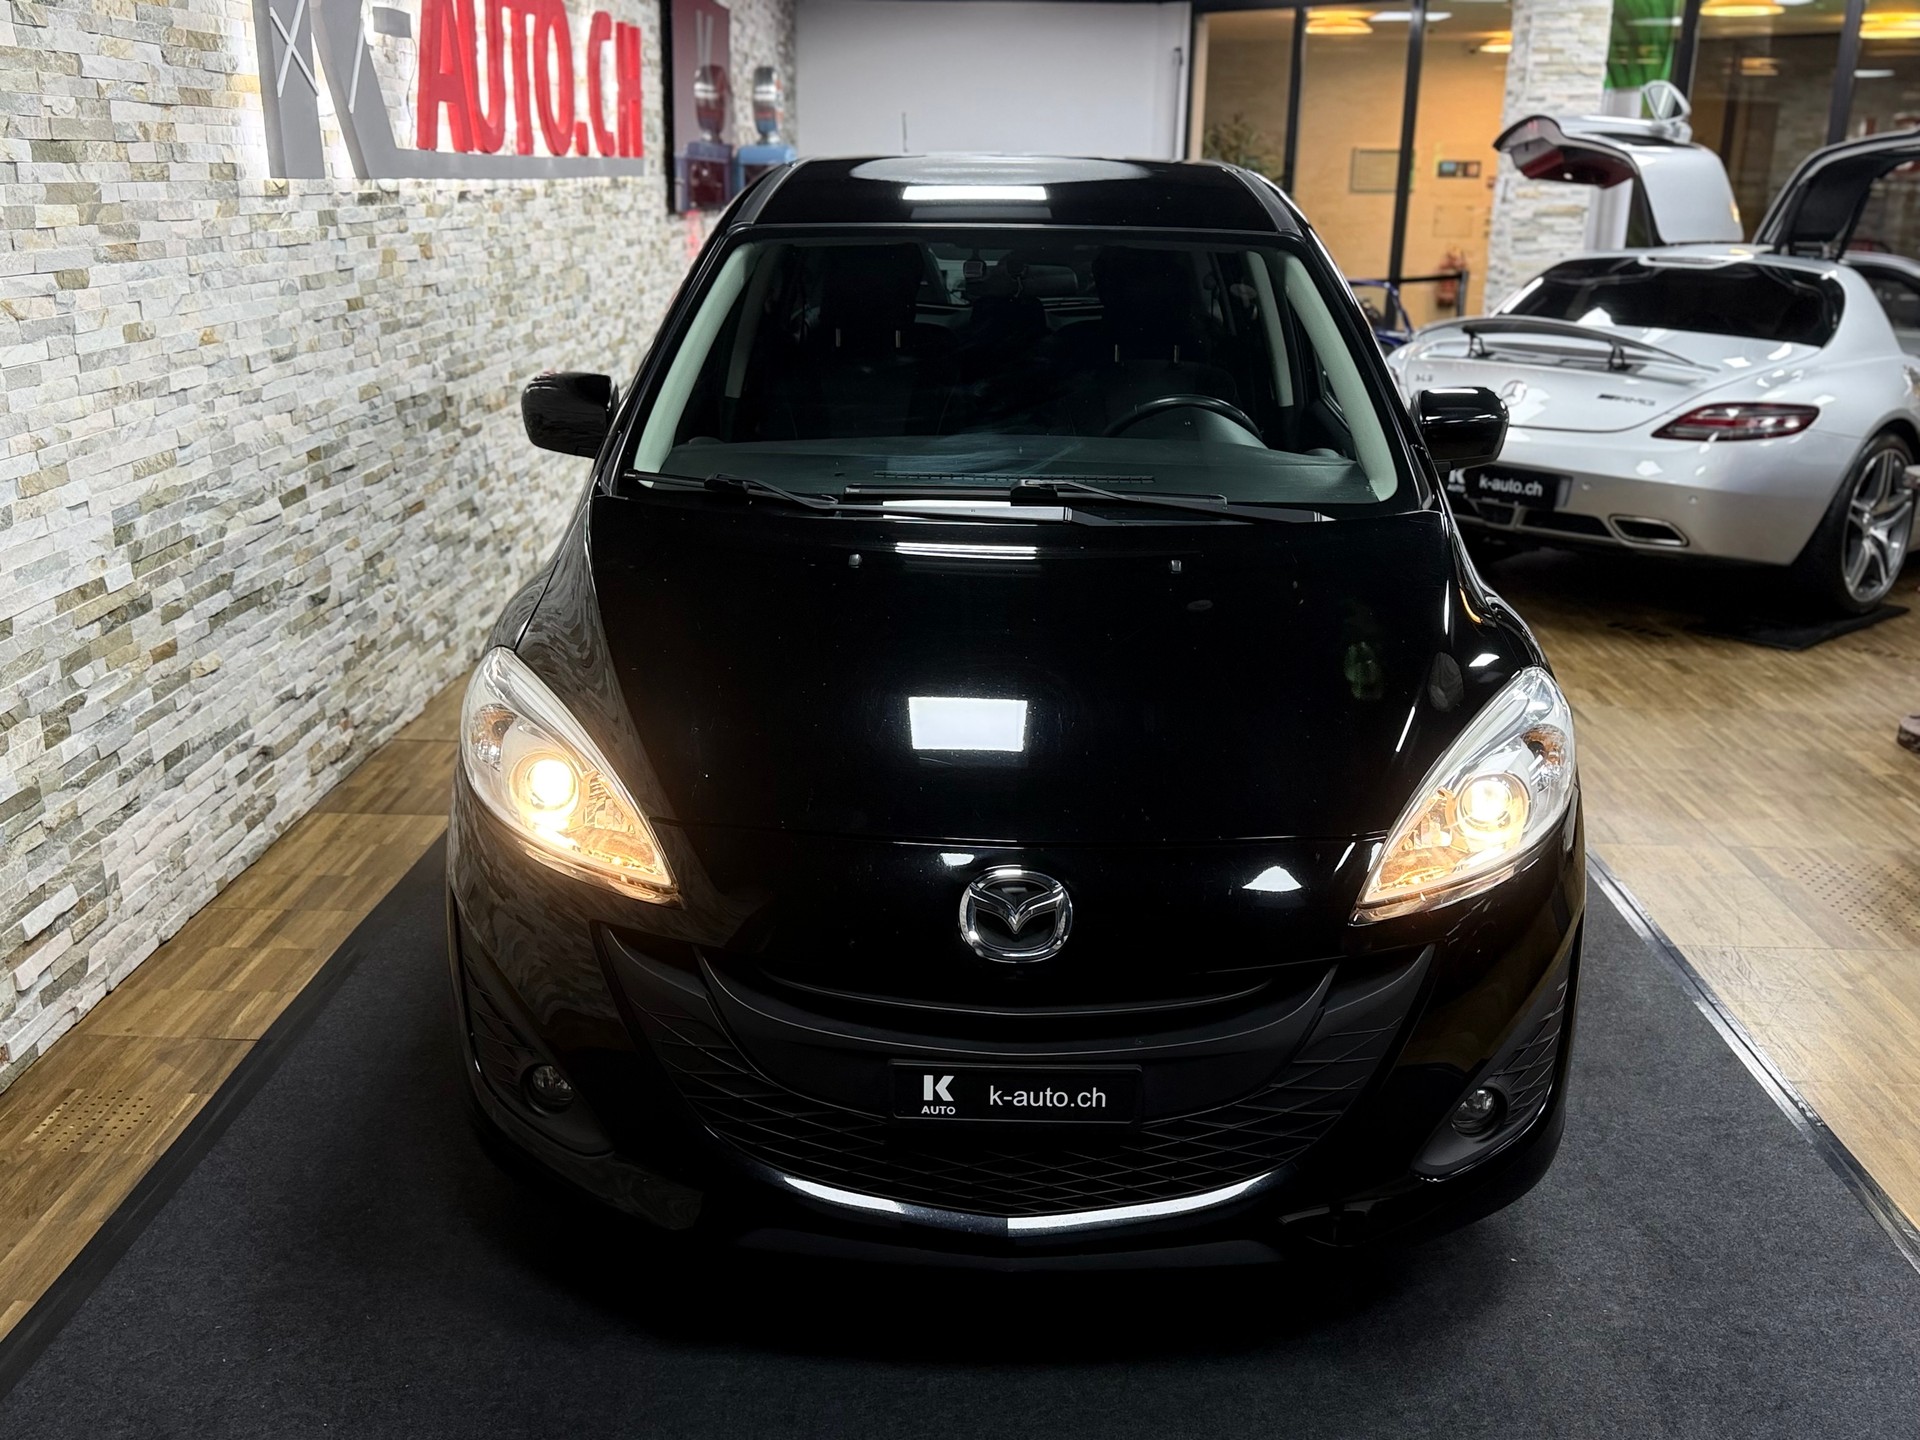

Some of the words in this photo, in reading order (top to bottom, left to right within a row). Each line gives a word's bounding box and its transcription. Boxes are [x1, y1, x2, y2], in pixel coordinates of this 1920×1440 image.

[1479, 473, 1543, 497] k-auto.ch
[923, 1075, 955, 1102] K
[989, 1085, 1106, 1108] k-auto.ch
[921, 1105, 956, 1115] AUTO
